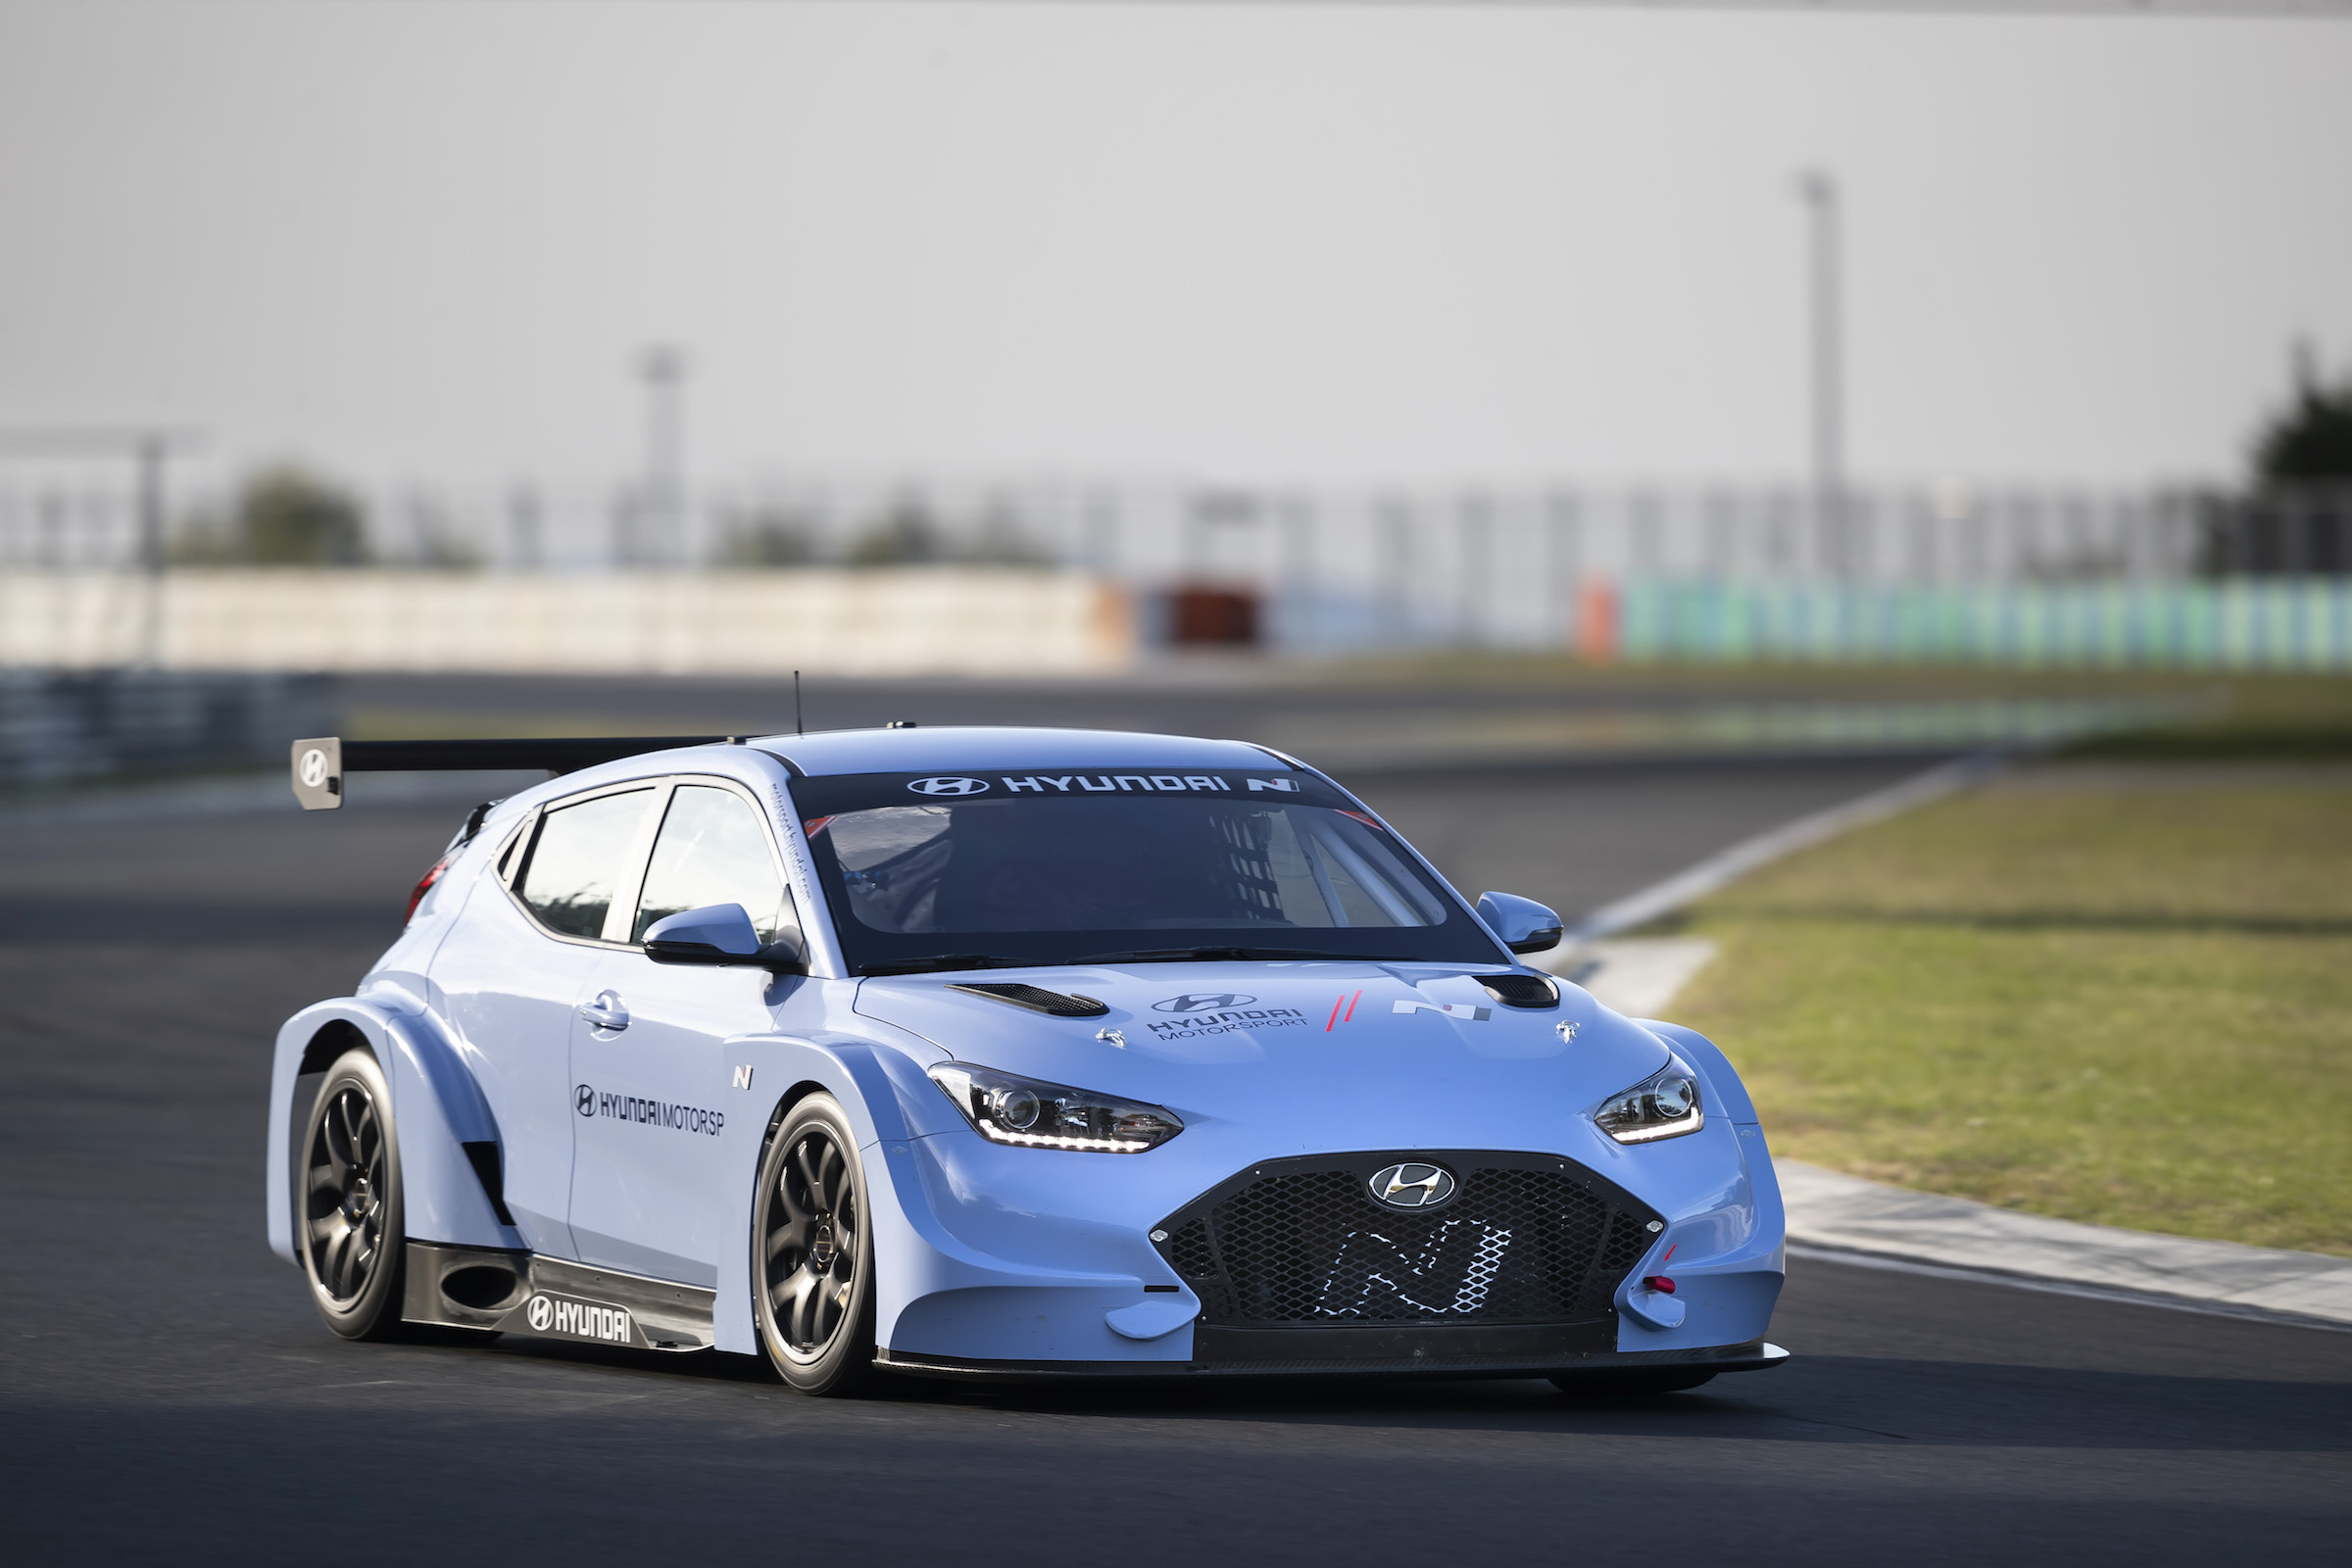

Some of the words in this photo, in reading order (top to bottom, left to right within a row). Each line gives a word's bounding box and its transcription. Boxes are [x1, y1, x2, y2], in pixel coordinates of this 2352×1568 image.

[1001, 775, 1232, 793] HYUNDAI
[1246, 777, 1300, 793] N
[1147, 1008, 1303, 1032] HYUNDAI
[1157, 1017, 1310, 1041] MOTORSPORT
[731, 1063, 754, 1091] N
[600, 1091, 662, 1127] HYUNDAI
[662, 1102, 725, 1137] MOTORSP
[555, 1299, 632, 1344] HYUNDAI
